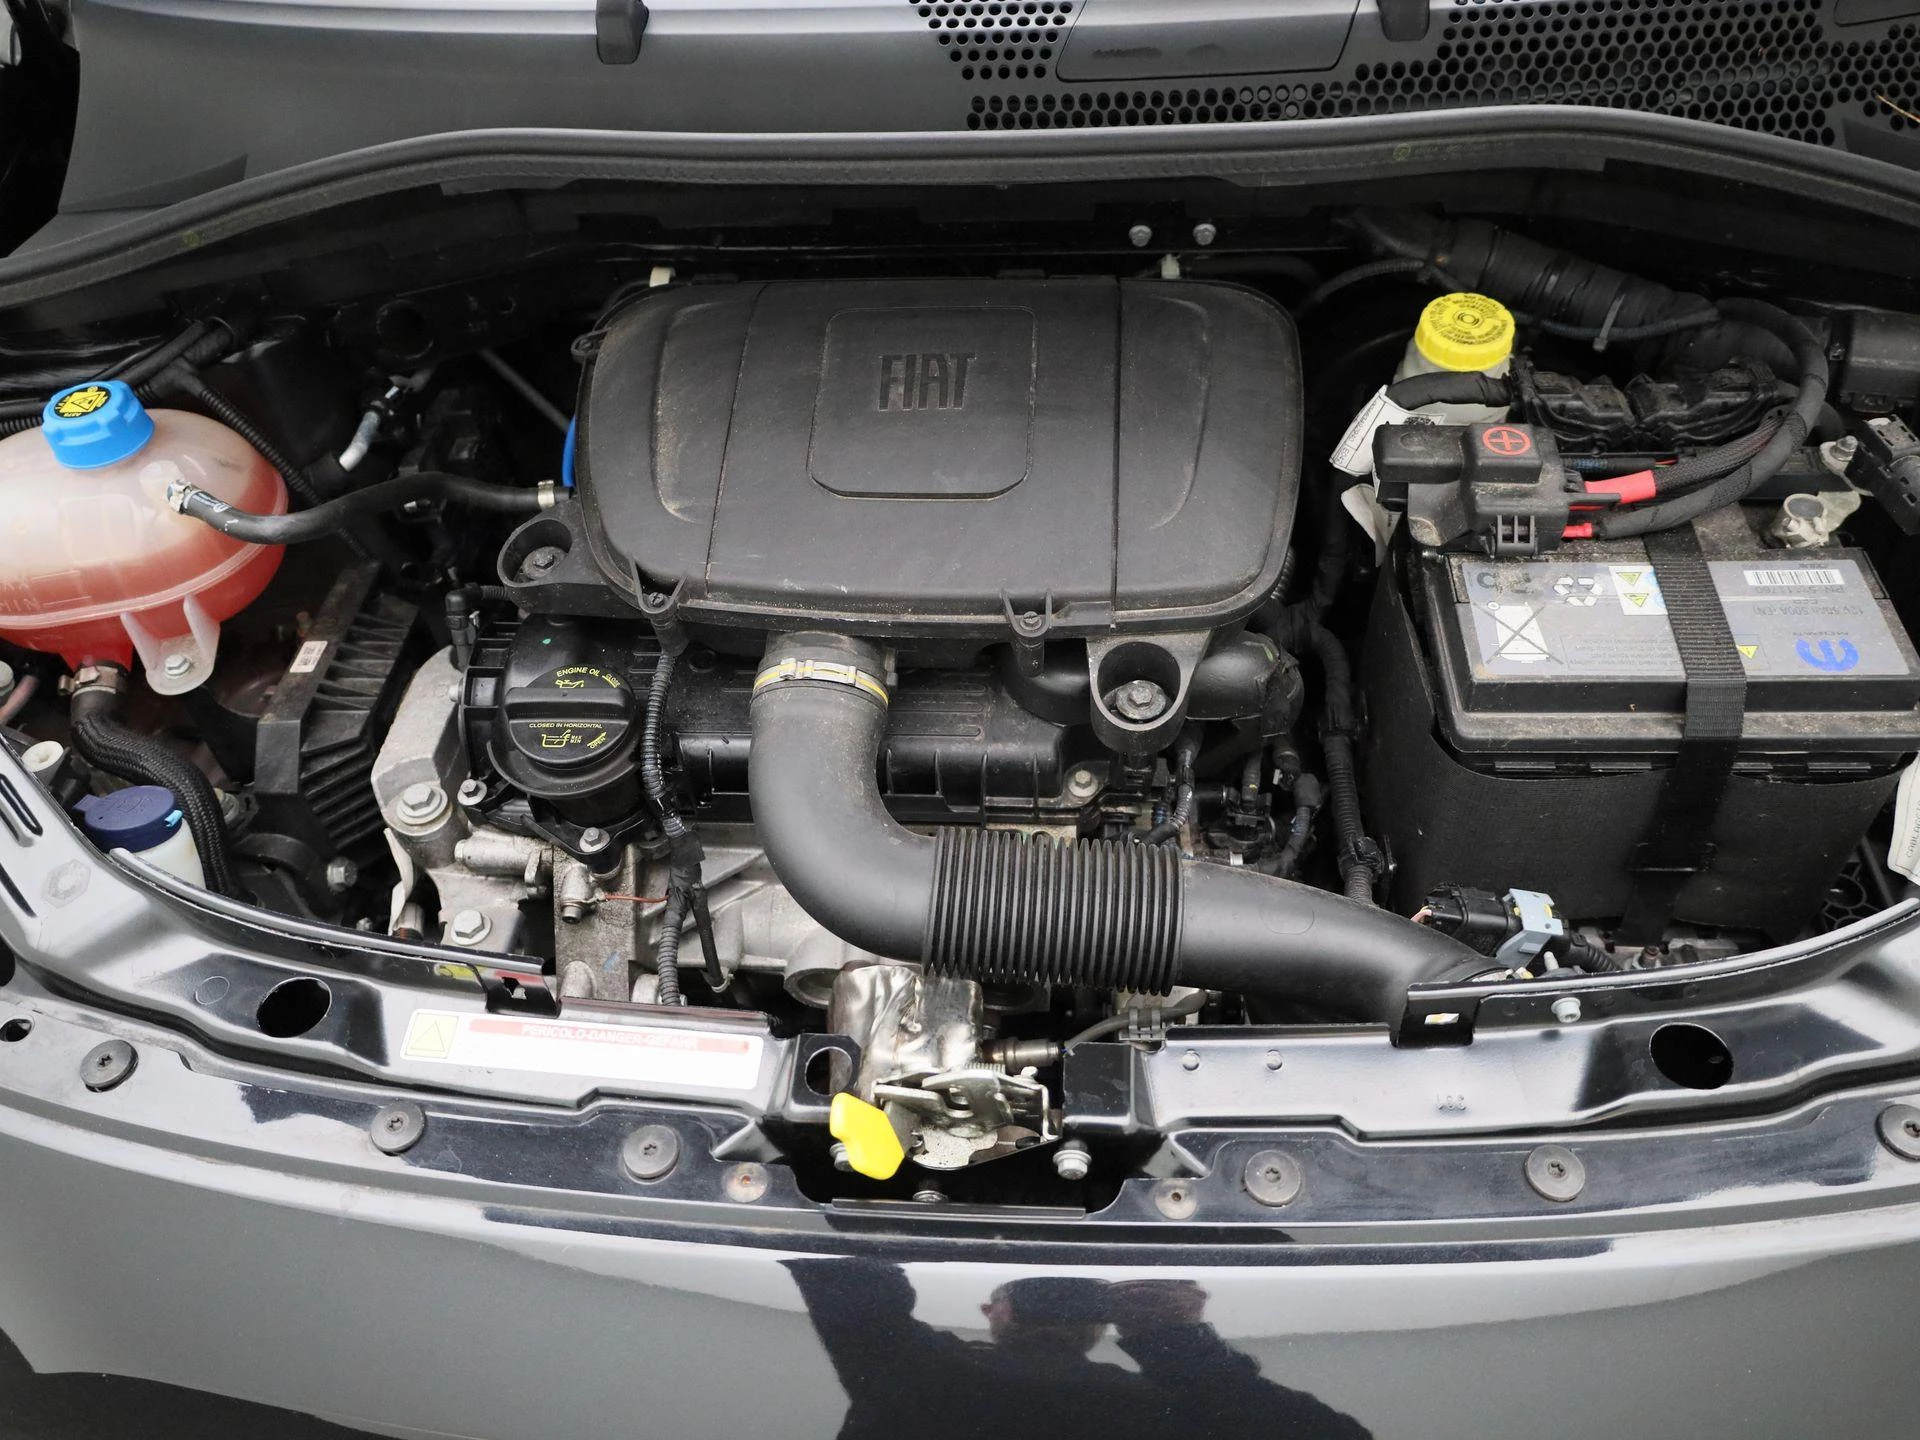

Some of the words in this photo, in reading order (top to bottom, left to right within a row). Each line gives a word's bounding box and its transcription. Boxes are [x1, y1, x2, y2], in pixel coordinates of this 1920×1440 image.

[878, 352, 976, 411] FIAT
[556, 667, 588, 677] ENGINE
[589, 668, 601, 677] OIL
